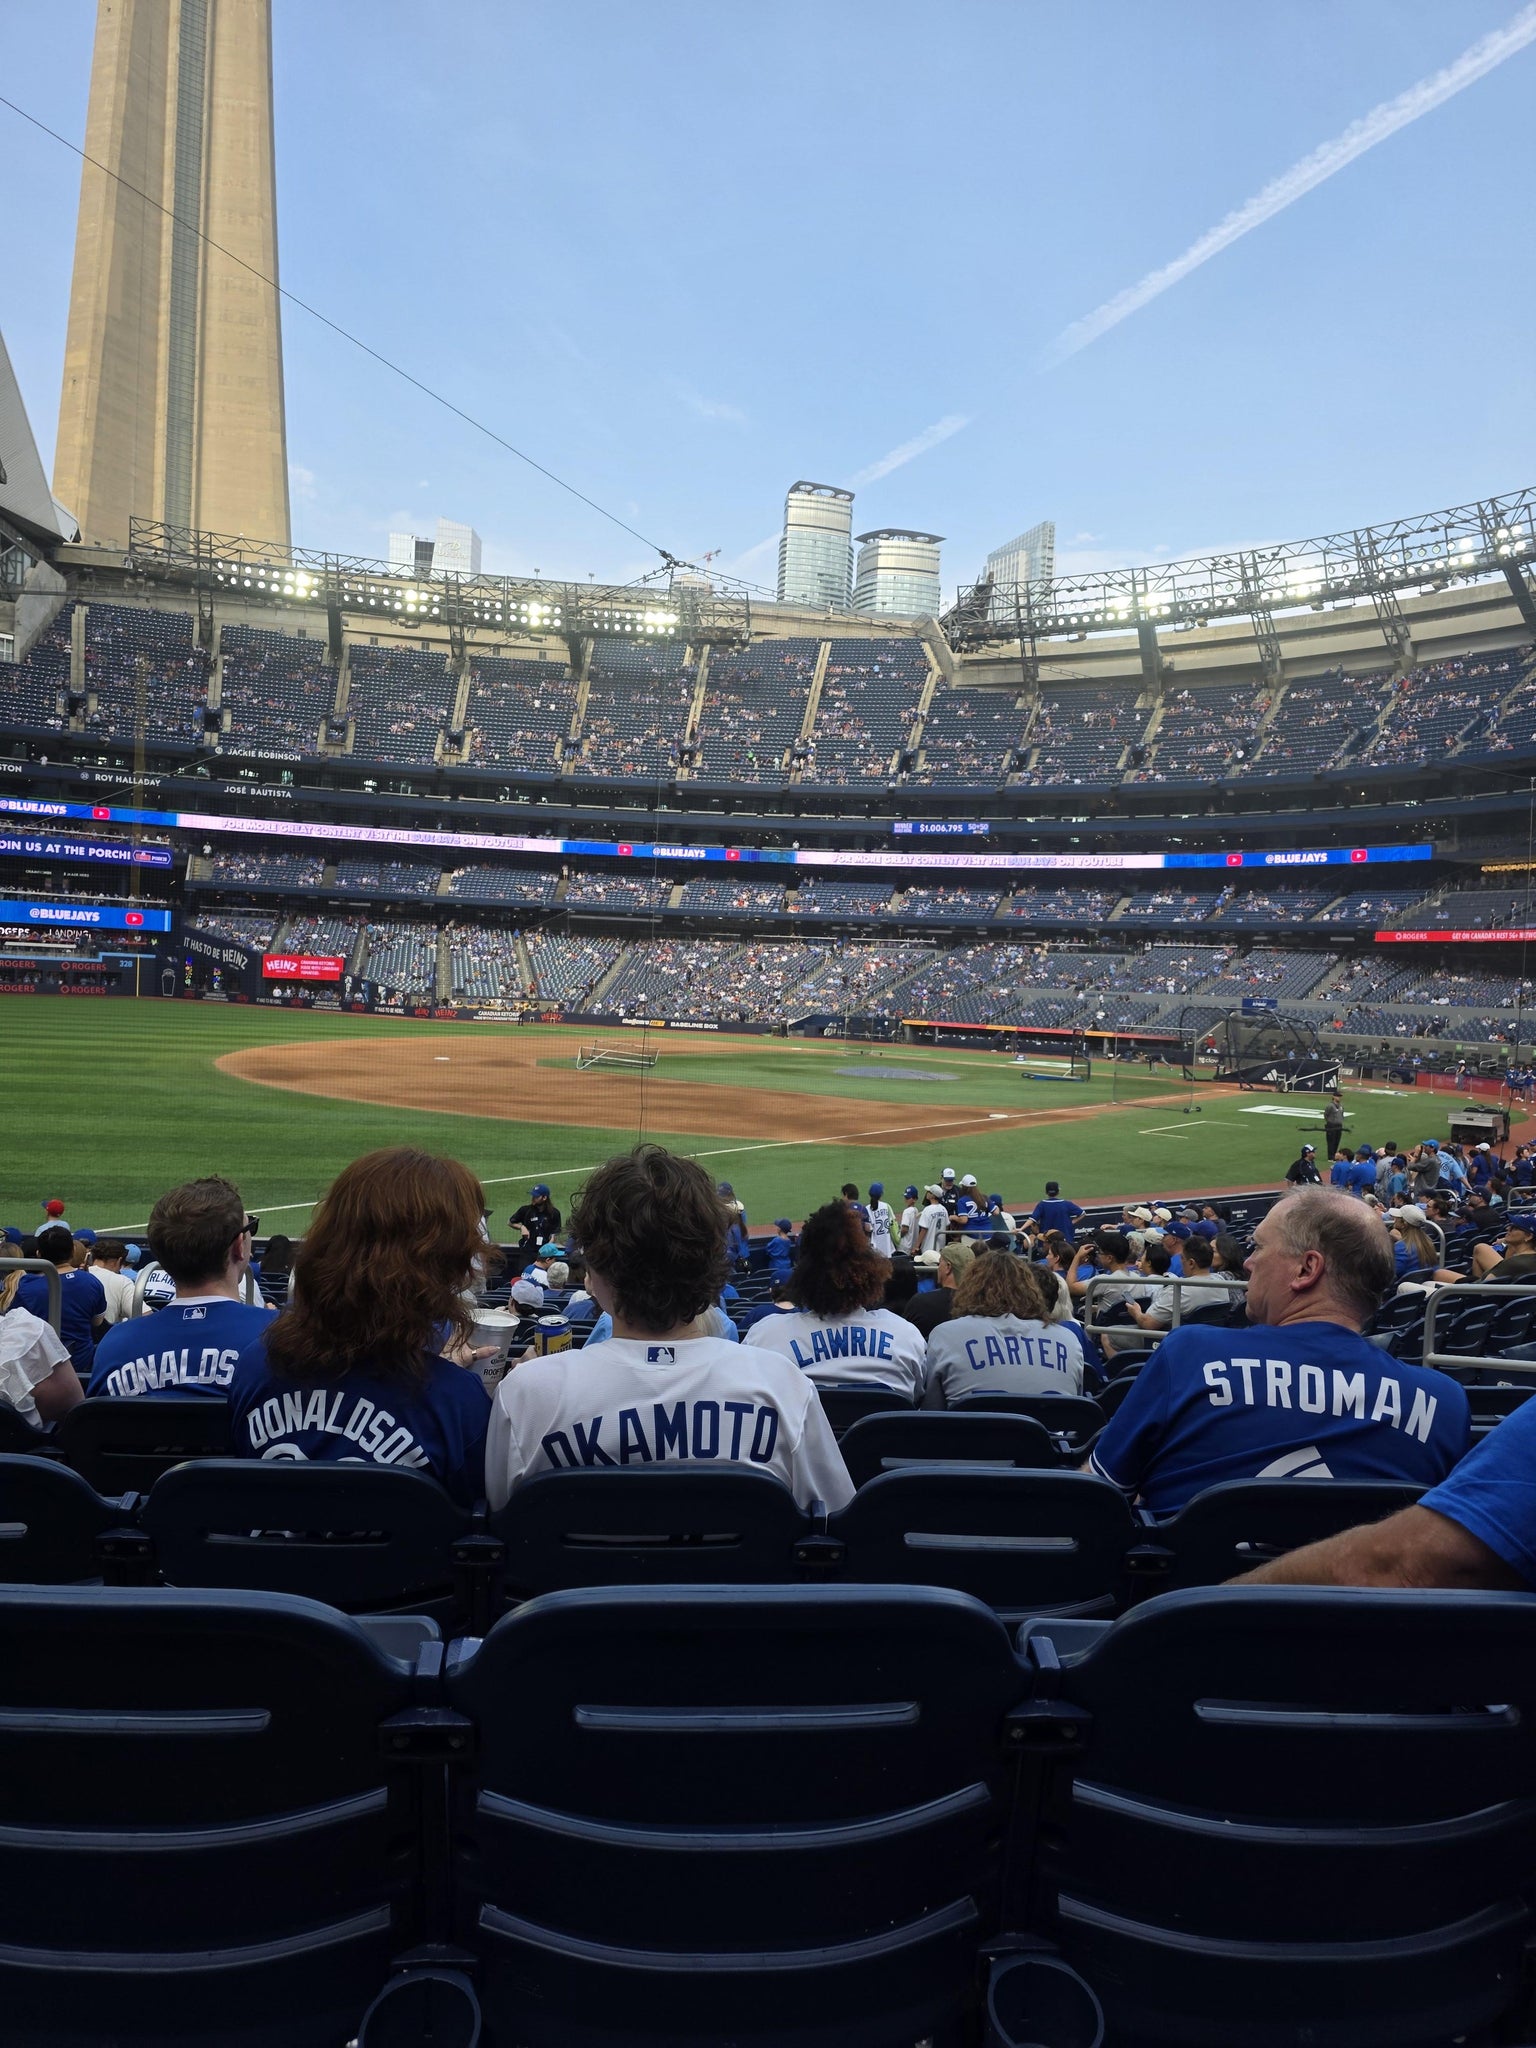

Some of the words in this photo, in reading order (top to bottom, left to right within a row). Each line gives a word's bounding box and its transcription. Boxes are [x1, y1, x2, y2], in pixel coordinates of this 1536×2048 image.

[228, 748, 256, 758] JACKIE
[258, 751, 301, 761] ROBINSON
[95, 773, 113, 783] ROY
[116, 775, 161, 787] HALLADAY
[224, 785, 246, 795] JOSÉ
[250, 787, 292, 798] BAUTISTA
[0, 801, 67, 815] @BLUEJAYS
[246, 821, 277, 832] MORE
[279, 823, 313, 834] GREAT
[315, 826, 362, 838] CONTENT
[364, 829, 389, 840] VISIT
[390, 831, 409, 842] THE
[462, 835, 477, 846] ON
[480, 837, 523, 848] YOUTUBE
[0, 840, 22, 851] OIN
[25, 842, 42, 852] US
[45, 843, 61, 854] AT
[64, 845, 85, 856] THE
[88, 848, 131, 860] PORCH!
[652, 847, 706, 858] @BLUEJAYS
[884, 855, 914, 865] GREAT
[917, 856, 960, 865] CONTENT
[961, 856, 987, 866] VISIT
[988, 856, 1006, 866] THE
[1057, 857, 1074, 866] ON
[1075, 856, 1123, 866] YOUTUBE
[1265, 852, 1328, 864] @BLUEJAYS
[29, 907, 100, 922] @BLUEJAYS
[1401, 932, 1427, 940] ROGERS
[183, 936, 190, 948] IT
[190, 940, 203, 953] HAS
[203, 944, 212, 955] TO
[212, 947, 221, 960] BE
[222, 949, 249, 970] HEINZ
[72, 962, 107, 971] ROGERS
[119, 960, 133, 968] 328
[266, 959, 299, 972] HEINZ
[71, 985, 106, 994] ROGERS
[434, 1009, 458, 1017] HEINZ
[150, 1272, 177, 1287] RLAN
[790, 1326, 894, 1367] LAWRIE
[965, 1335, 1067, 1373] CARTER
[106, 1348, 239, 1397] DONALDS
[1203, 1358, 1437, 1444] STROMAN
[541, 1401, 779, 1468] OKAMOTO
